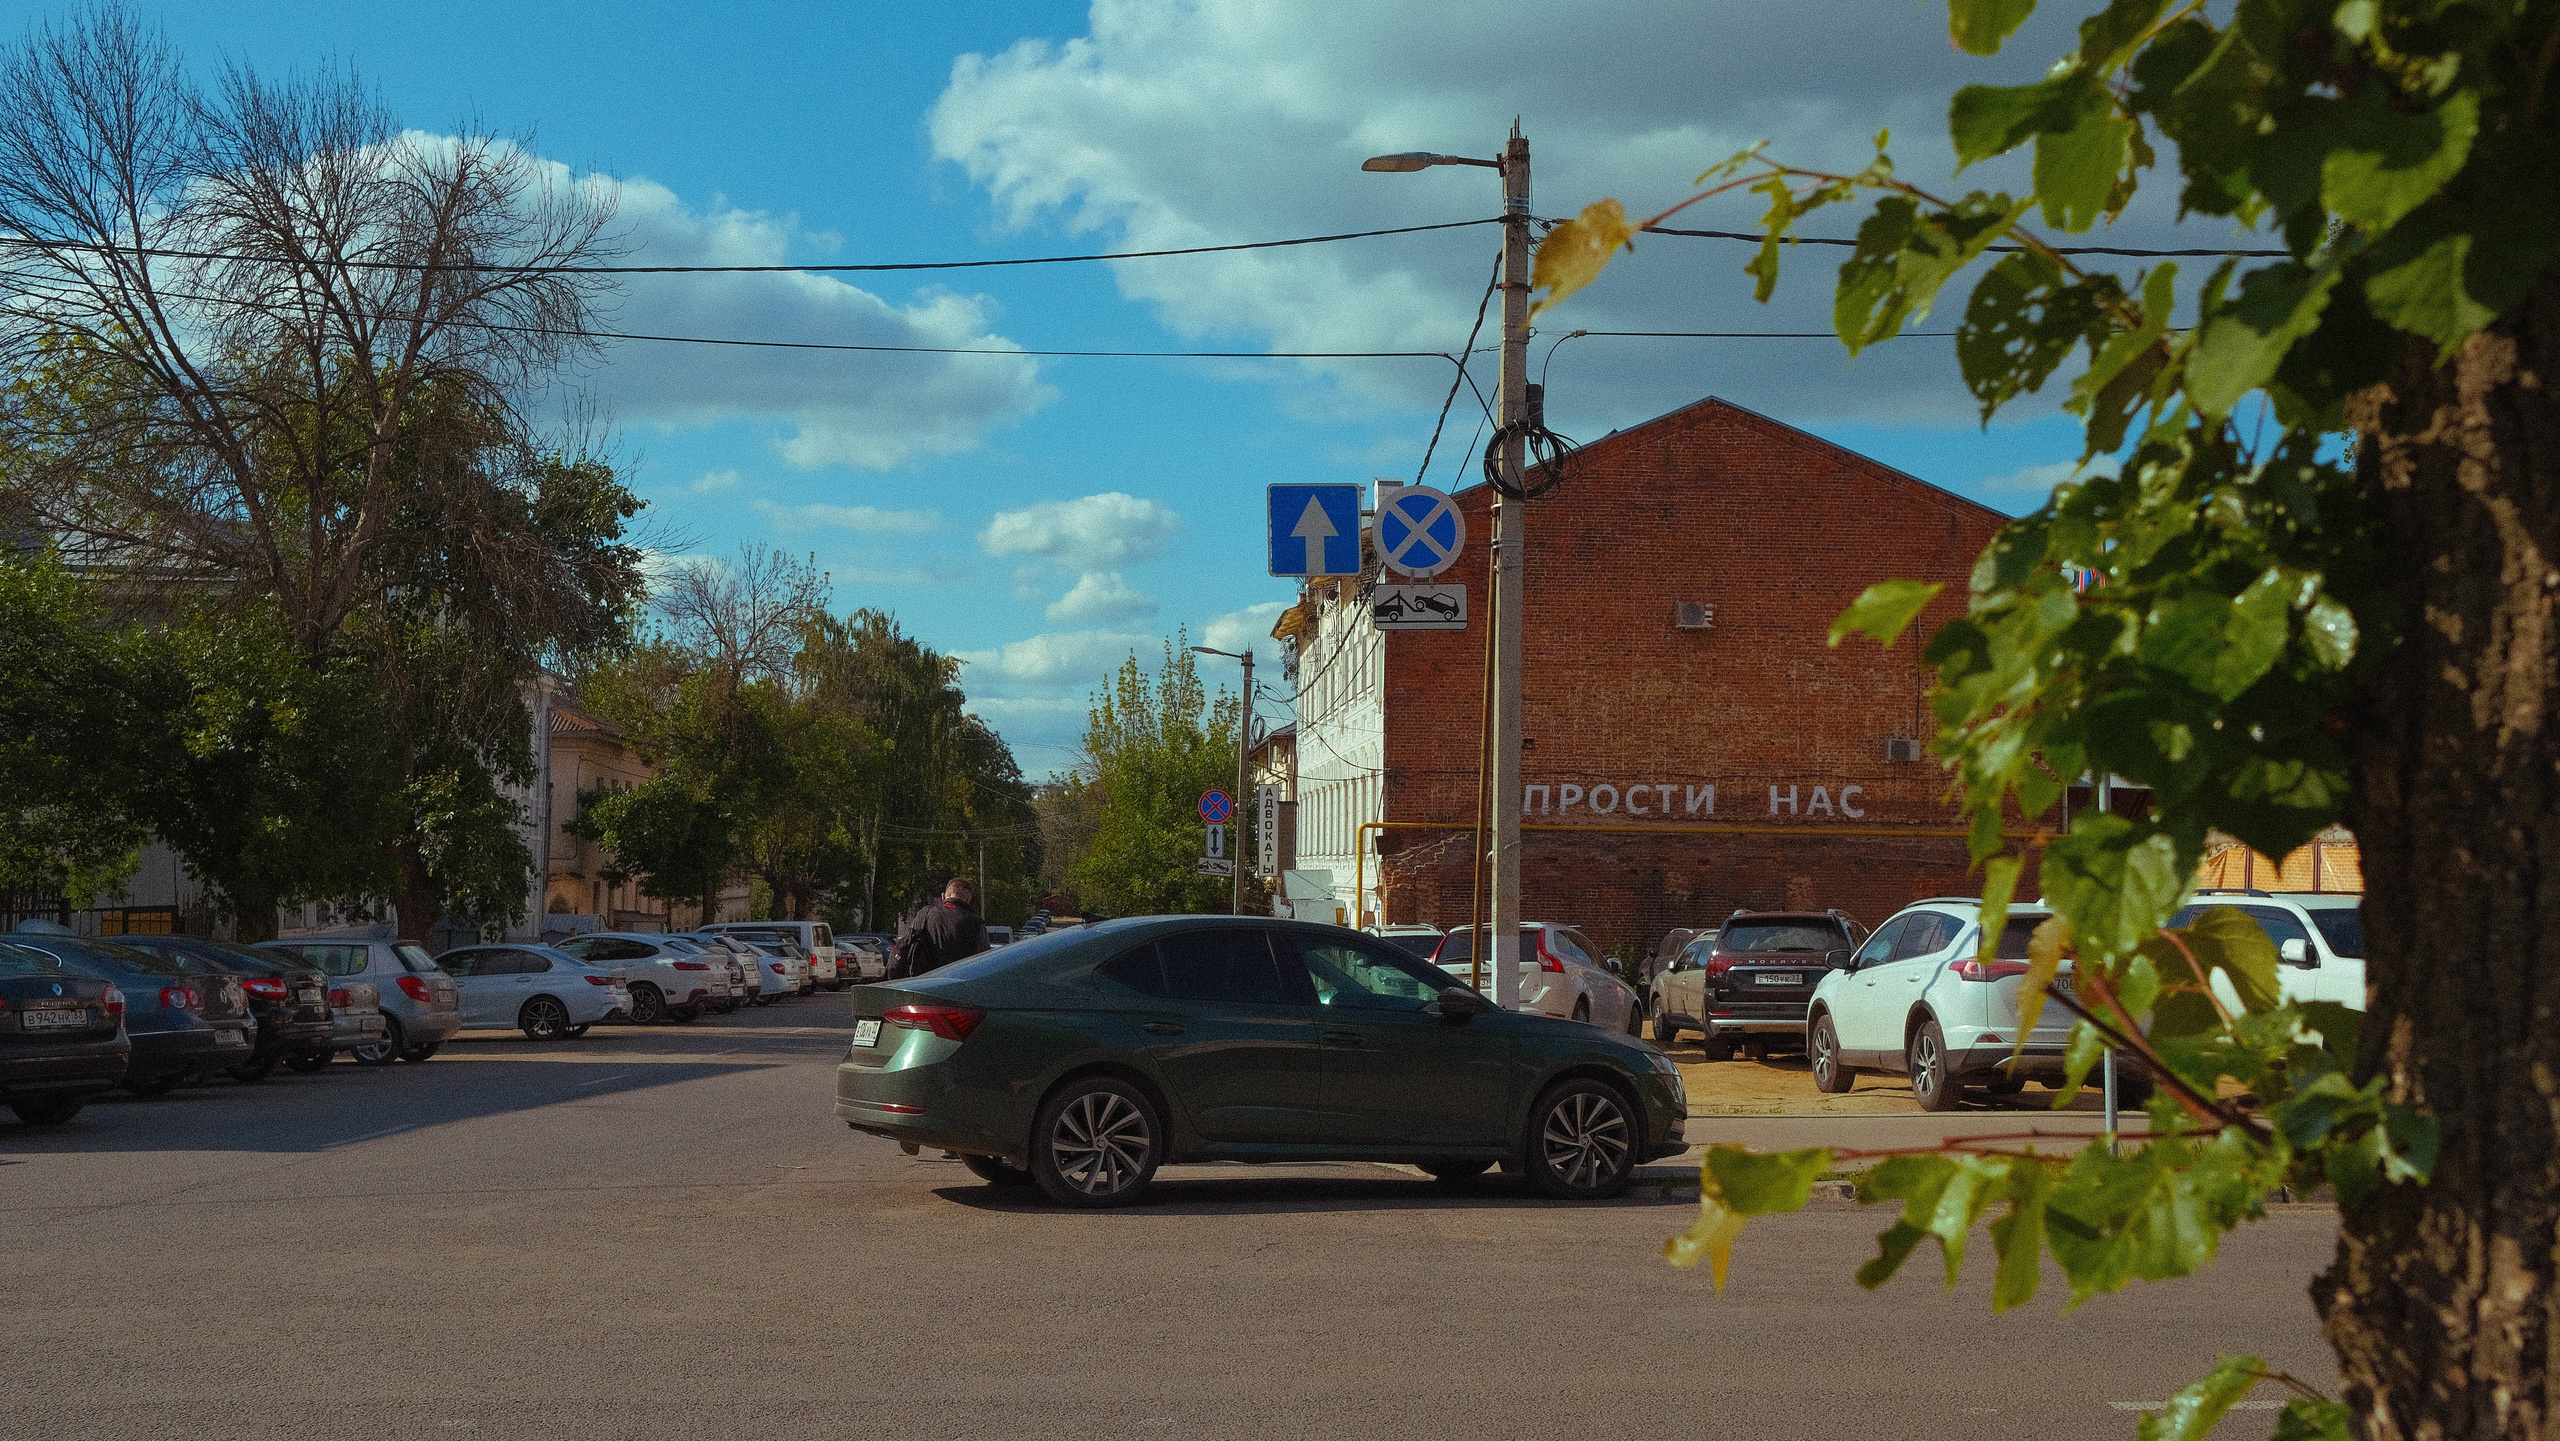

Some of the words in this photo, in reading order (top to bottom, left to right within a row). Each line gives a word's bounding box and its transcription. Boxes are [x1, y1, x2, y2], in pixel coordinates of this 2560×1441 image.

[1523, 783, 1715, 815] ПРОСТИ
[1769, 785, 1865, 818] НАС
[1263, 788, 1274, 874] АДВОКАТЫ
